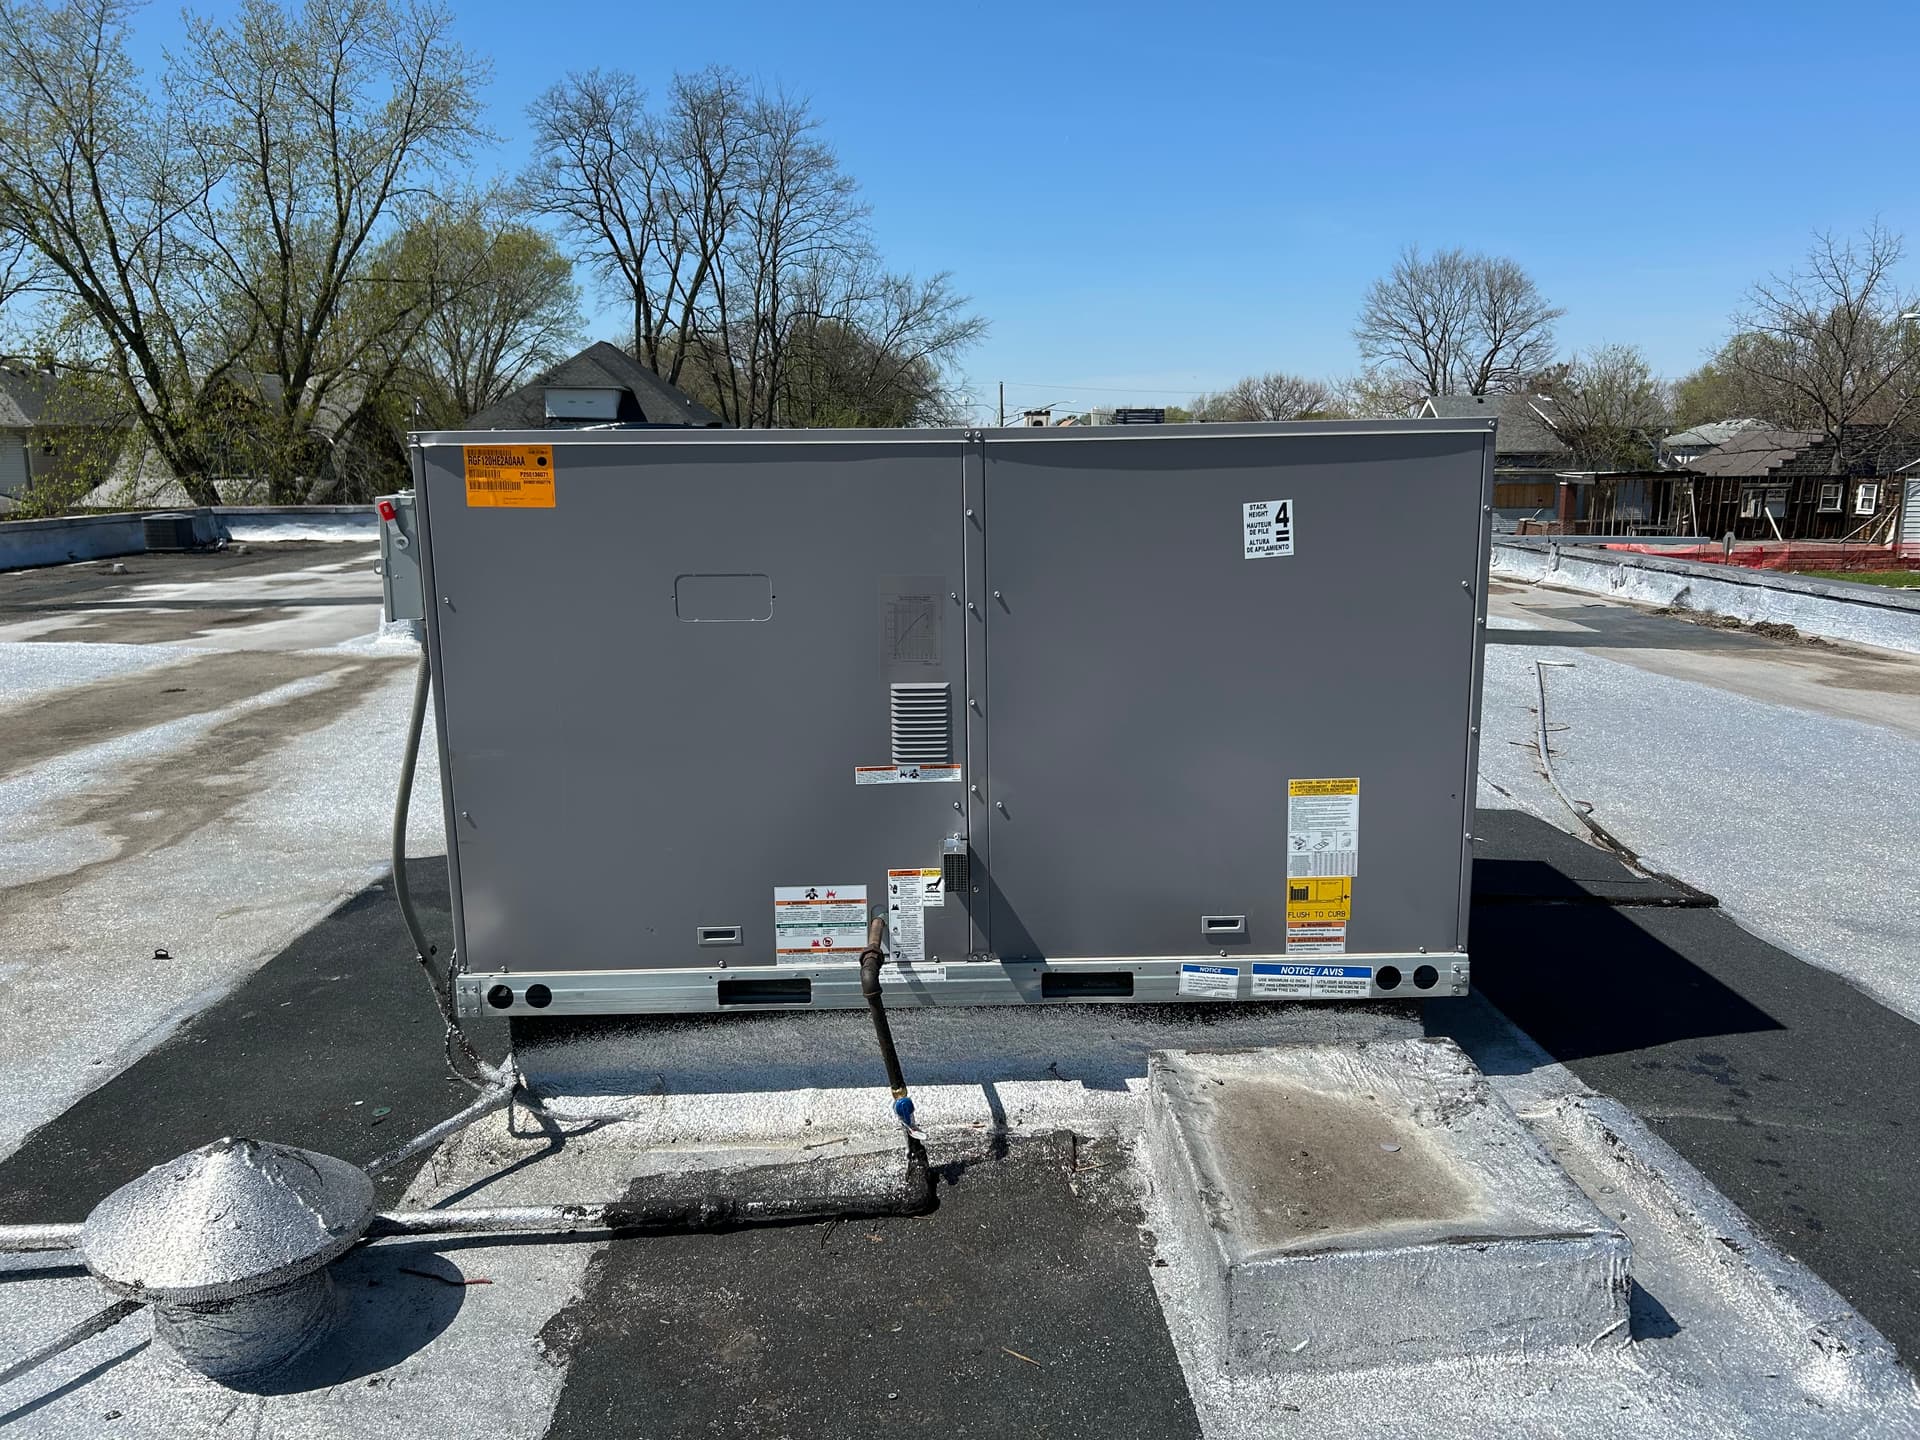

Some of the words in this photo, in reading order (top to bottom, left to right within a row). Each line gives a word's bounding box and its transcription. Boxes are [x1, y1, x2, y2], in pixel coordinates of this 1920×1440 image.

[1275, 502, 1289, 528] 4
[1255, 544, 1290, 552] APILAMIENTO
[1280, 966, 1316, 975] NOTICE
[1323, 968, 1344, 976] AVIS
